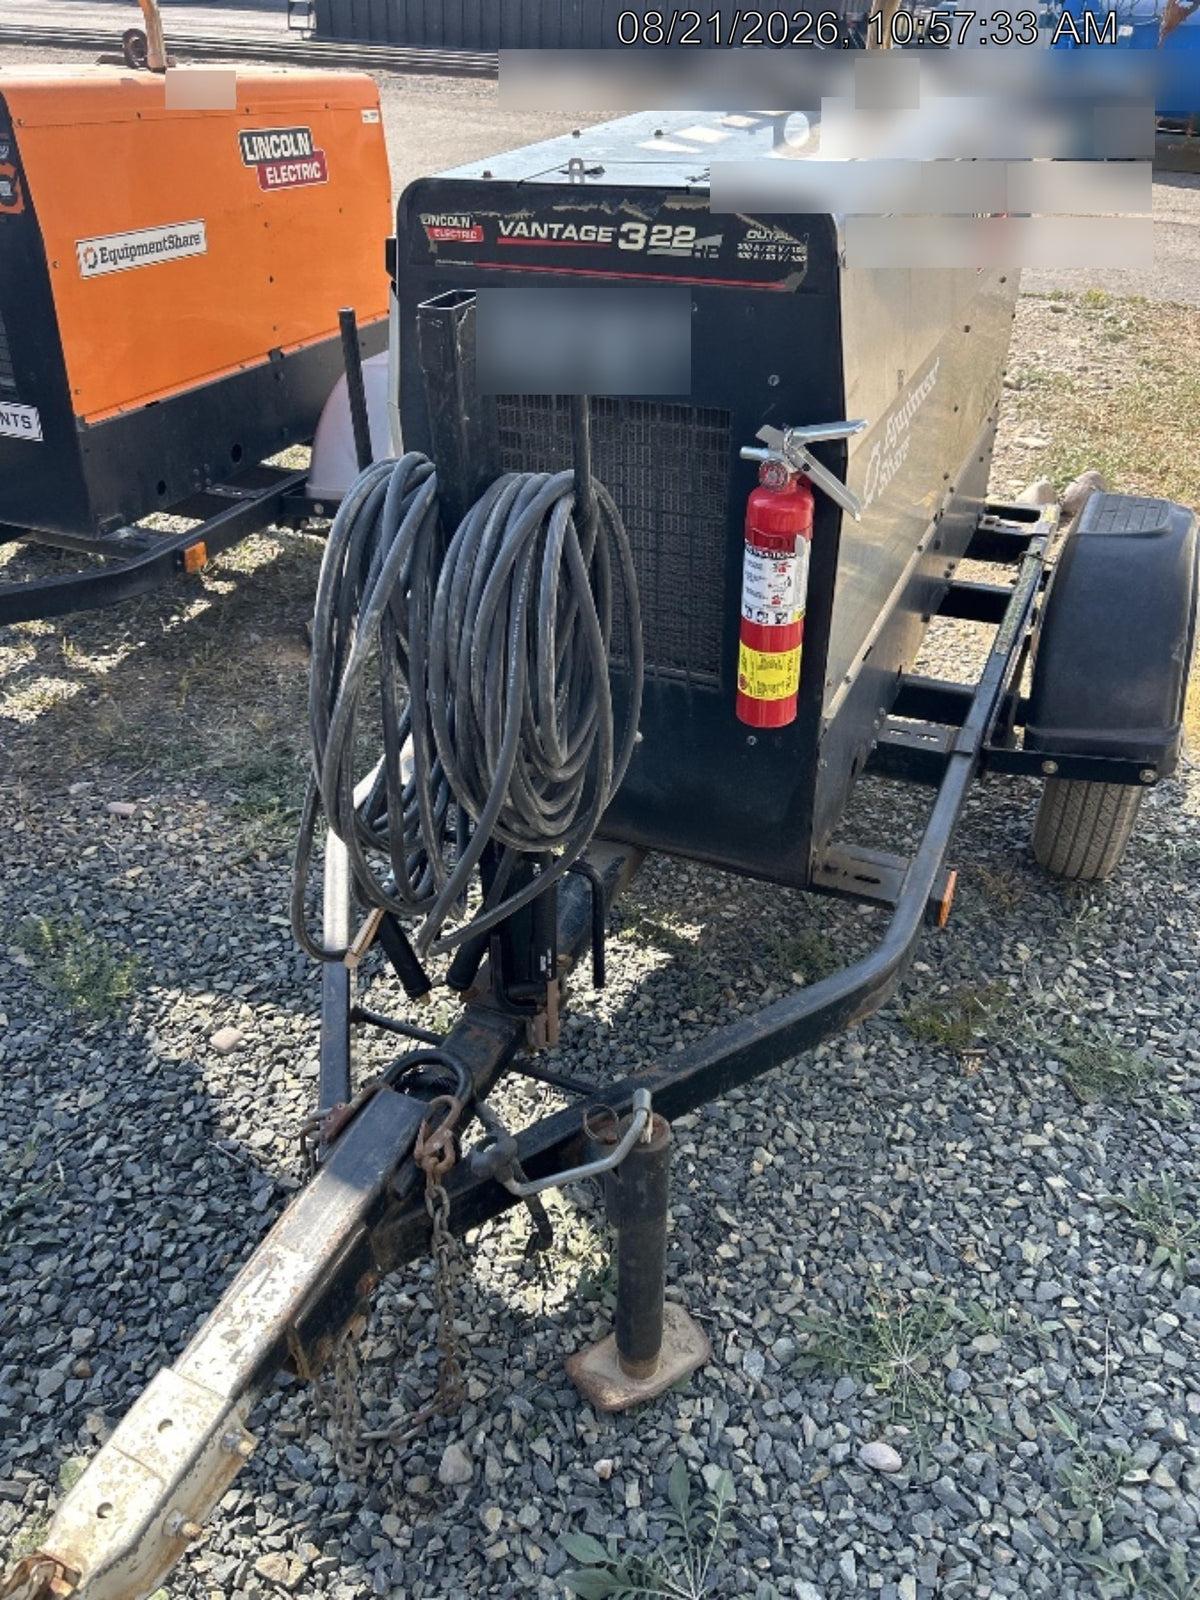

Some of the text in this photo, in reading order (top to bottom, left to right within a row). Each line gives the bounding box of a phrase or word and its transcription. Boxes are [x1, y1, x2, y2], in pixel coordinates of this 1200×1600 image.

[243, 133, 312, 161] LINCOLN
[266, 161, 321, 185] ELECTRIC
[433, 228, 477, 239] ELECTRIC
[498, 220, 613, 243] VANTAGE
[618, 222, 696, 251] 322
[99, 234, 201, 265] EquipmentShare
